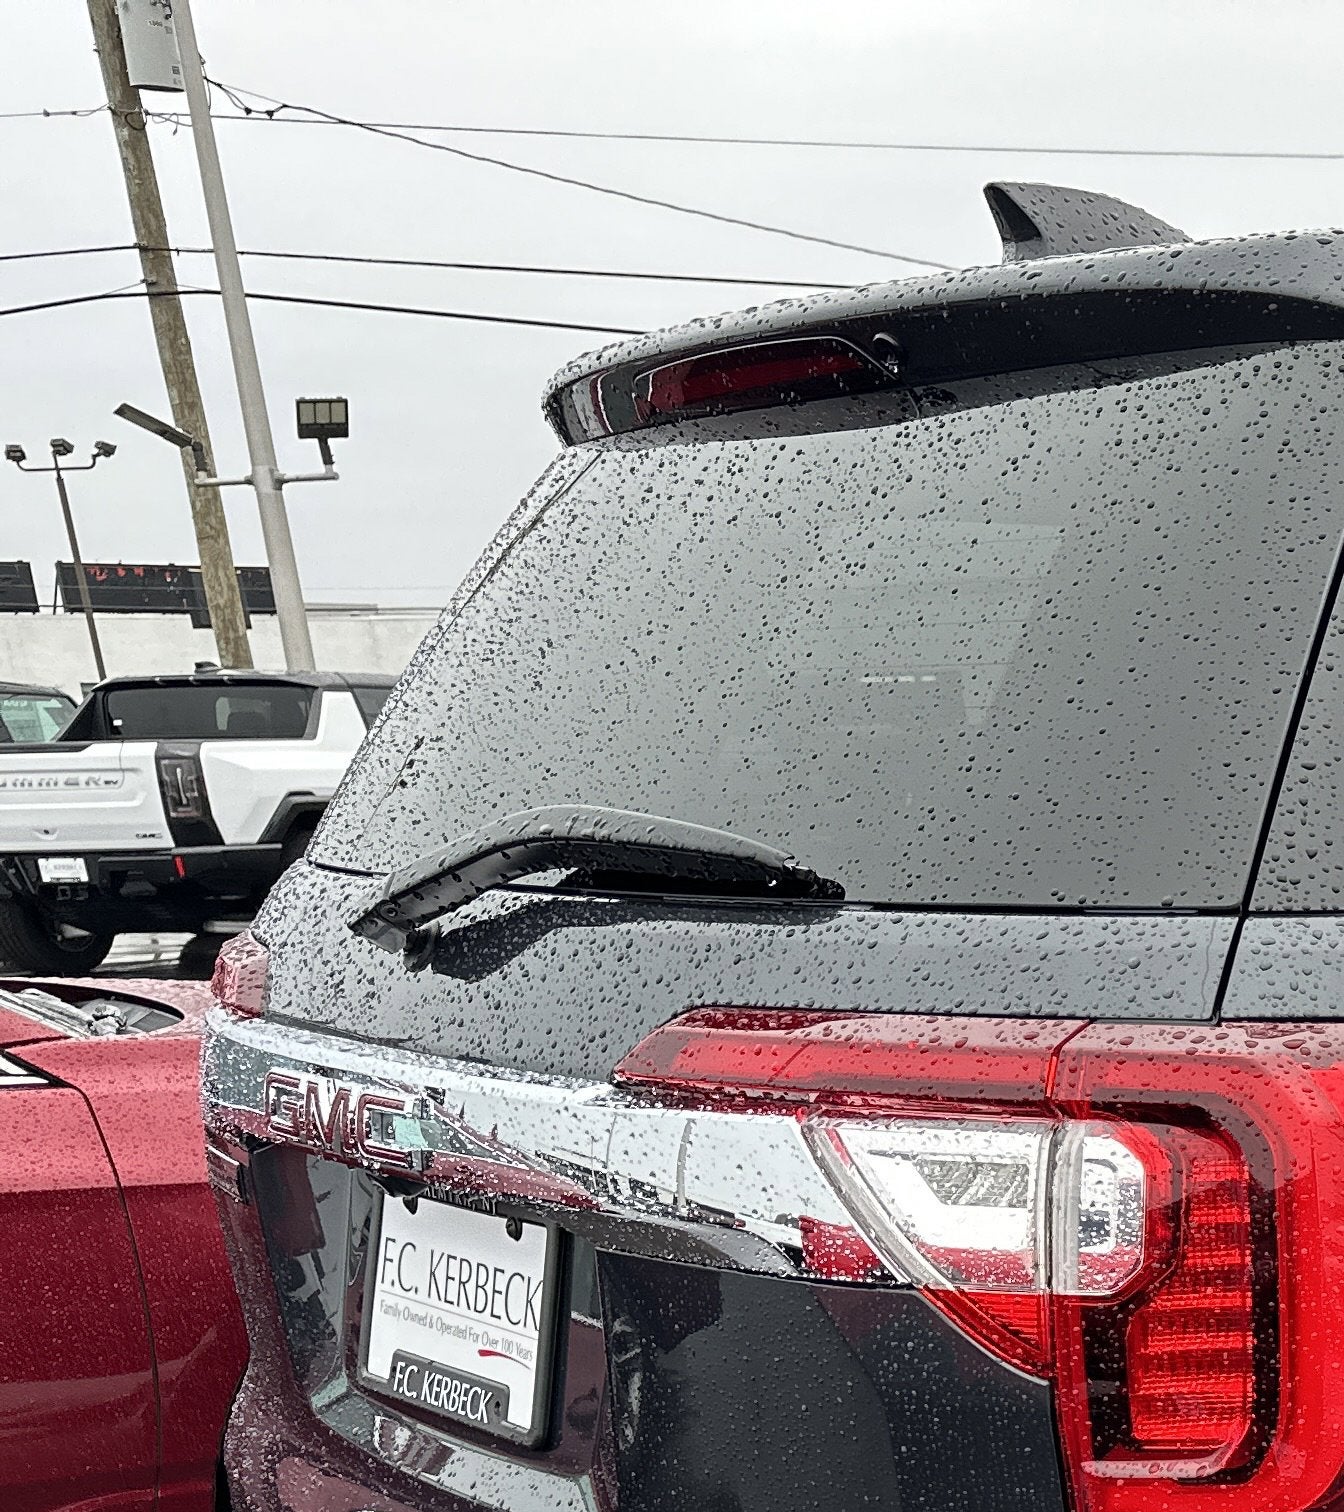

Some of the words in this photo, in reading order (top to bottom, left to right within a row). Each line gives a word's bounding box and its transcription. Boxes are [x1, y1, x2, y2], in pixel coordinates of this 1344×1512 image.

[265, 1069, 410, 1168] GMC
[381, 1237, 418, 1294] F.C.
[428, 1249, 543, 1332] KERBECK
[380, 1299, 402, 1323] Family
[403, 1306, 427, 1327] Owned
[428, 1315, 435, 1329] &
[436, 1317, 467, 1341] Operated
[468, 1326, 481, 1344] For
[482, 1330, 500, 1350] Over
[501, 1337, 514, 1354] 100
[516, 1342, 534, 1362] Years
[393, 1362, 418, 1399] F.C.
[420, 1370, 492, 1424] KERBECK
